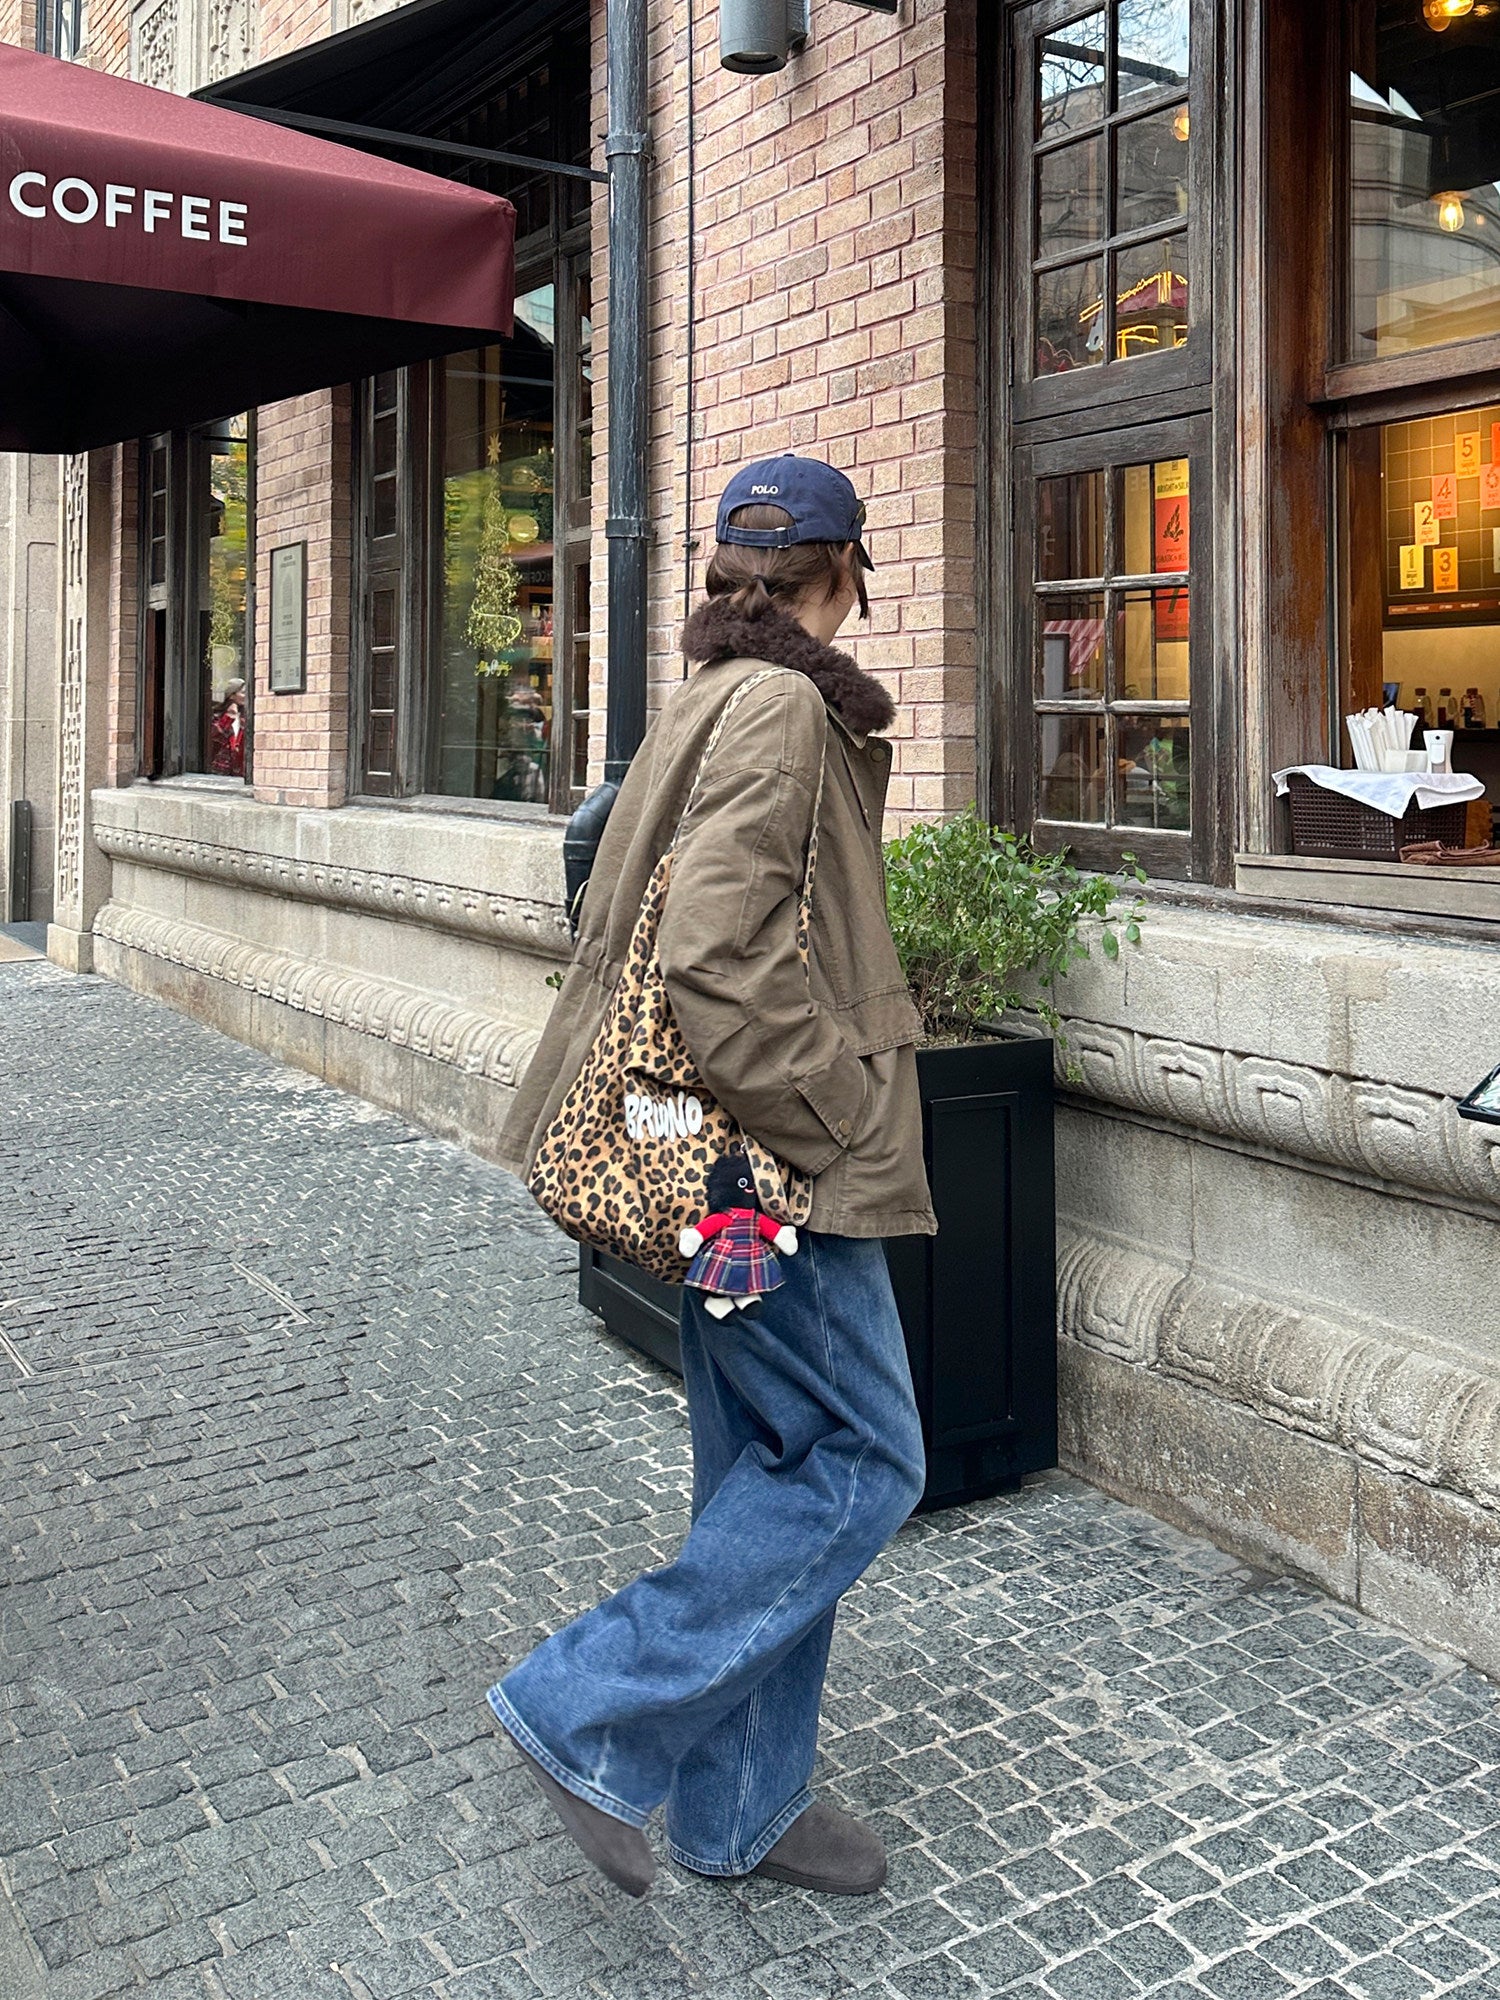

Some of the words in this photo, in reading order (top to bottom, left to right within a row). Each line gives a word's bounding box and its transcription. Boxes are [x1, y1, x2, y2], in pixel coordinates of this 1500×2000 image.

[9, 171, 248, 246] COFFEE
[1462, 436, 1474, 457] 5
[751, 485, 779, 495] POLO
[1436, 477, 1452, 499] 4
[1163, 504, 1184, 542] 4
[1421, 505, 1433, 525] 2
[1408, 548, 1414, 569] 1
[1440, 551, 1451, 572] 3
[624, 1091, 703, 1143] BRUNO
